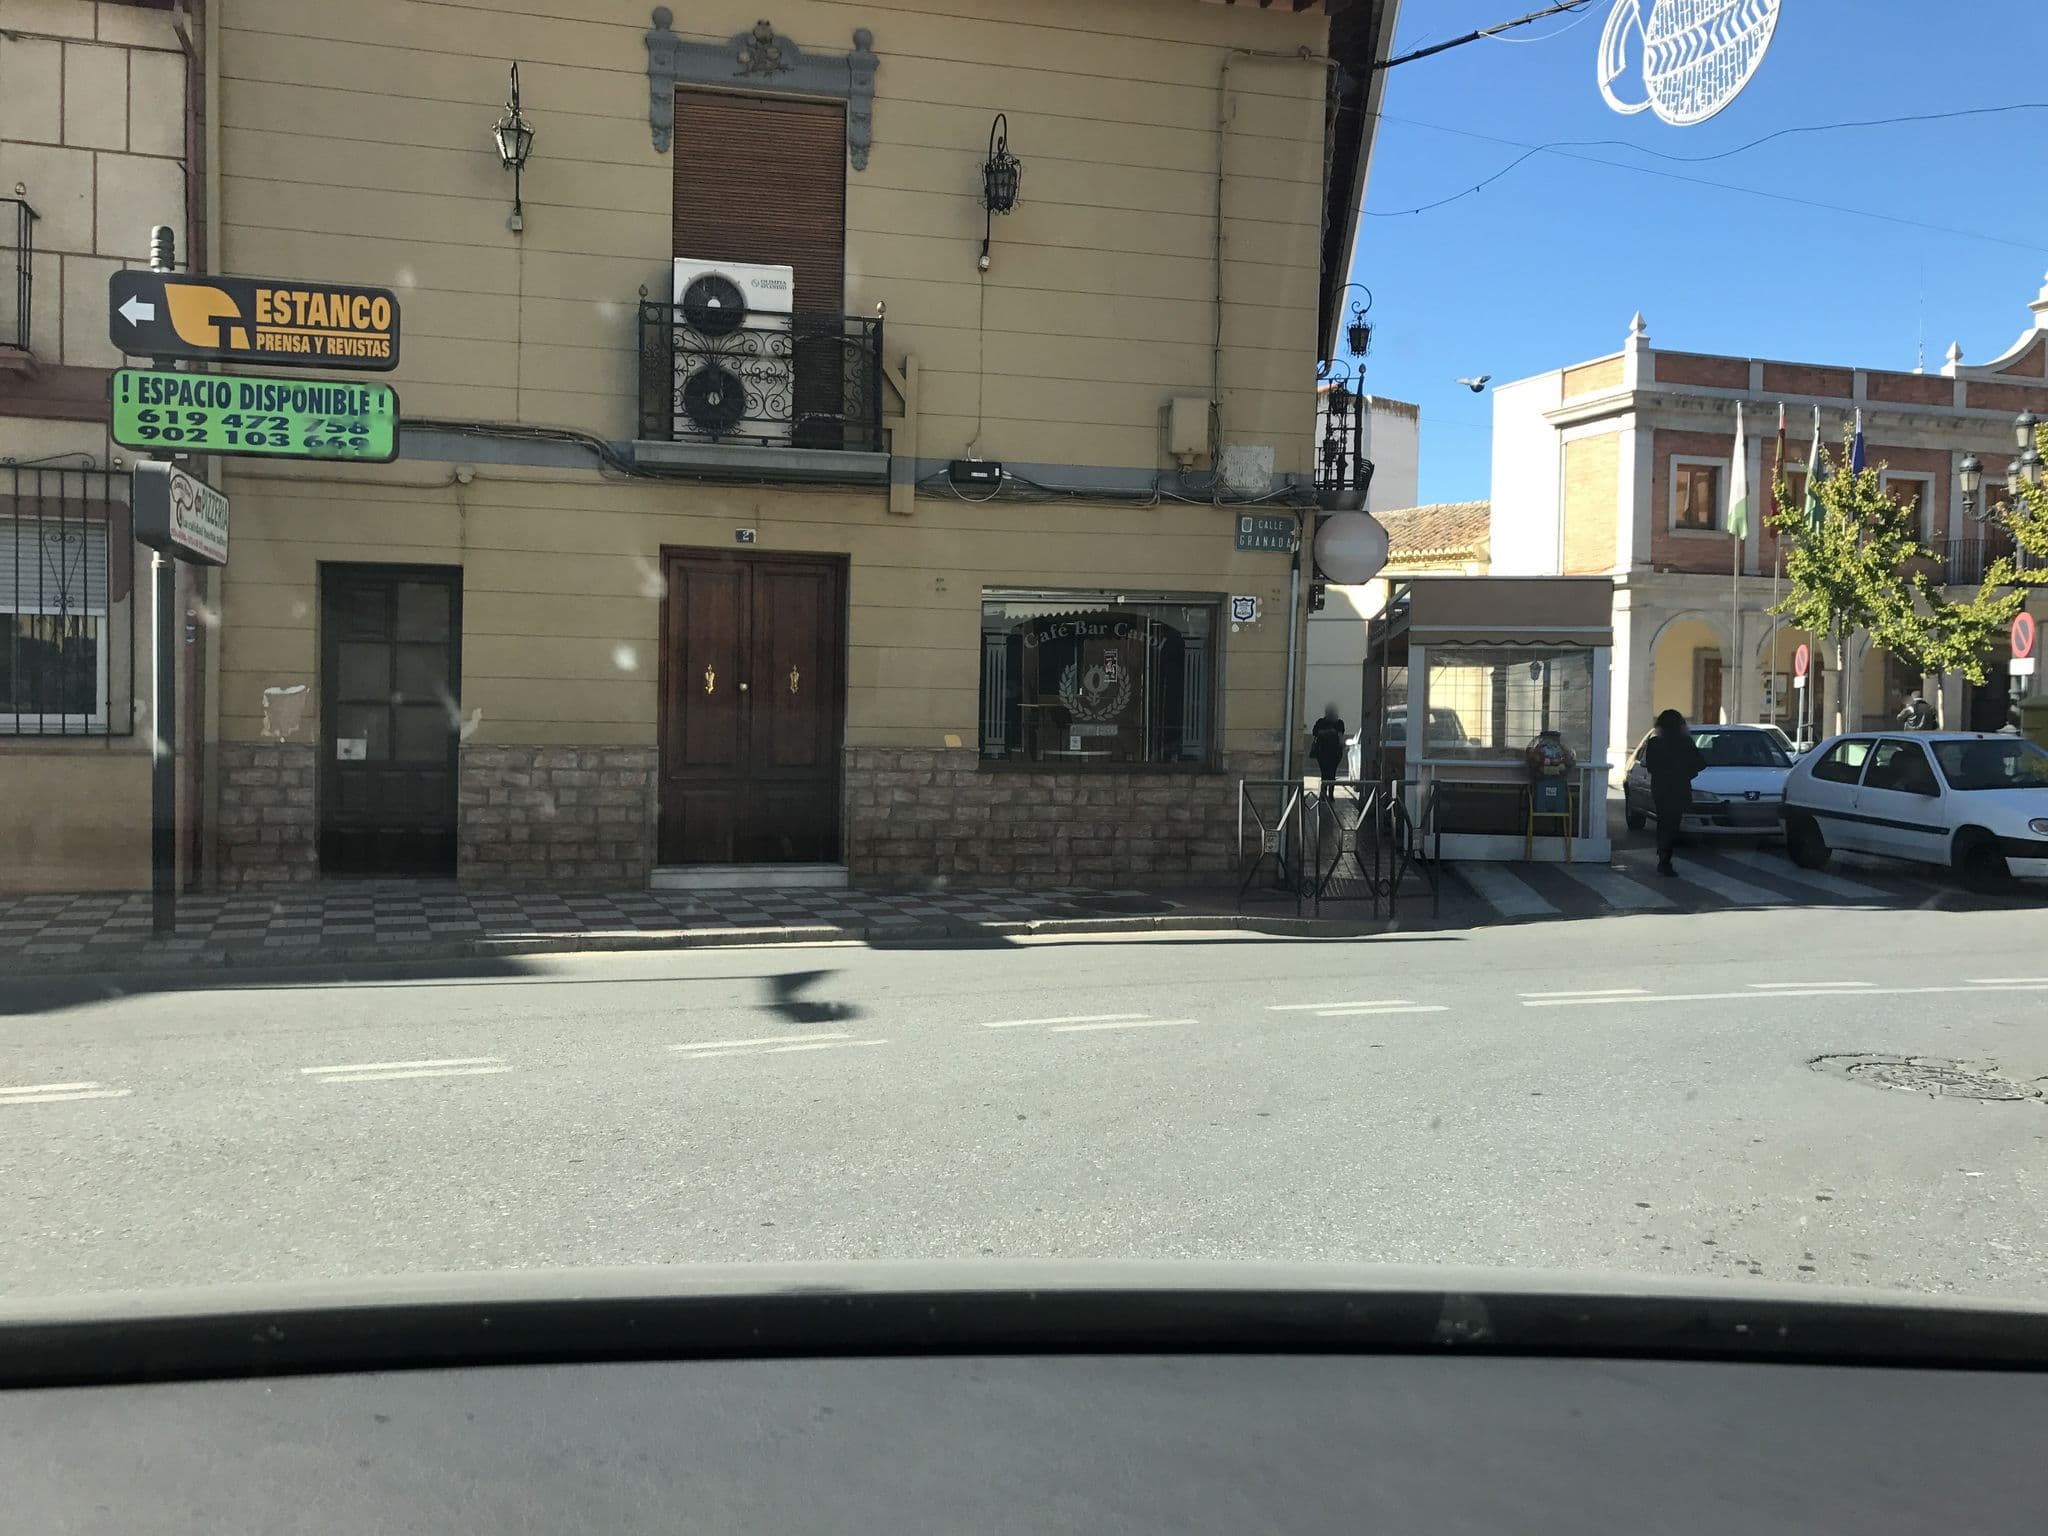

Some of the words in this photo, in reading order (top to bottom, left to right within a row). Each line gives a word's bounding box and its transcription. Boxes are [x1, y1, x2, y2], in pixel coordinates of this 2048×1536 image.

[256, 289, 391, 330] ESTANCO
[256, 332, 311, 353] PRENSA
[314, 336, 324, 354] Y
[327, 337, 390, 358] REVISTAS
[138, 376, 232, 409] ESPACIO
[239, 383, 370, 416] DISPONIBLE
[137, 409, 208, 426] 619
[221, 414, 290, 432] 472
[137, 425, 208, 443] 902
[225, 430, 290, 447] 103
[303, 435, 370, 451] 669
[201, 487, 228, 532] PIZZERIA
[742, 531, 751, 545] 2
[1258, 520, 1284, 530] CALLE
[1239, 535, 1291, 549] GRANADA
[1024, 622, 1069, 648] Café
[1075, 620, 1108, 635] Bar
